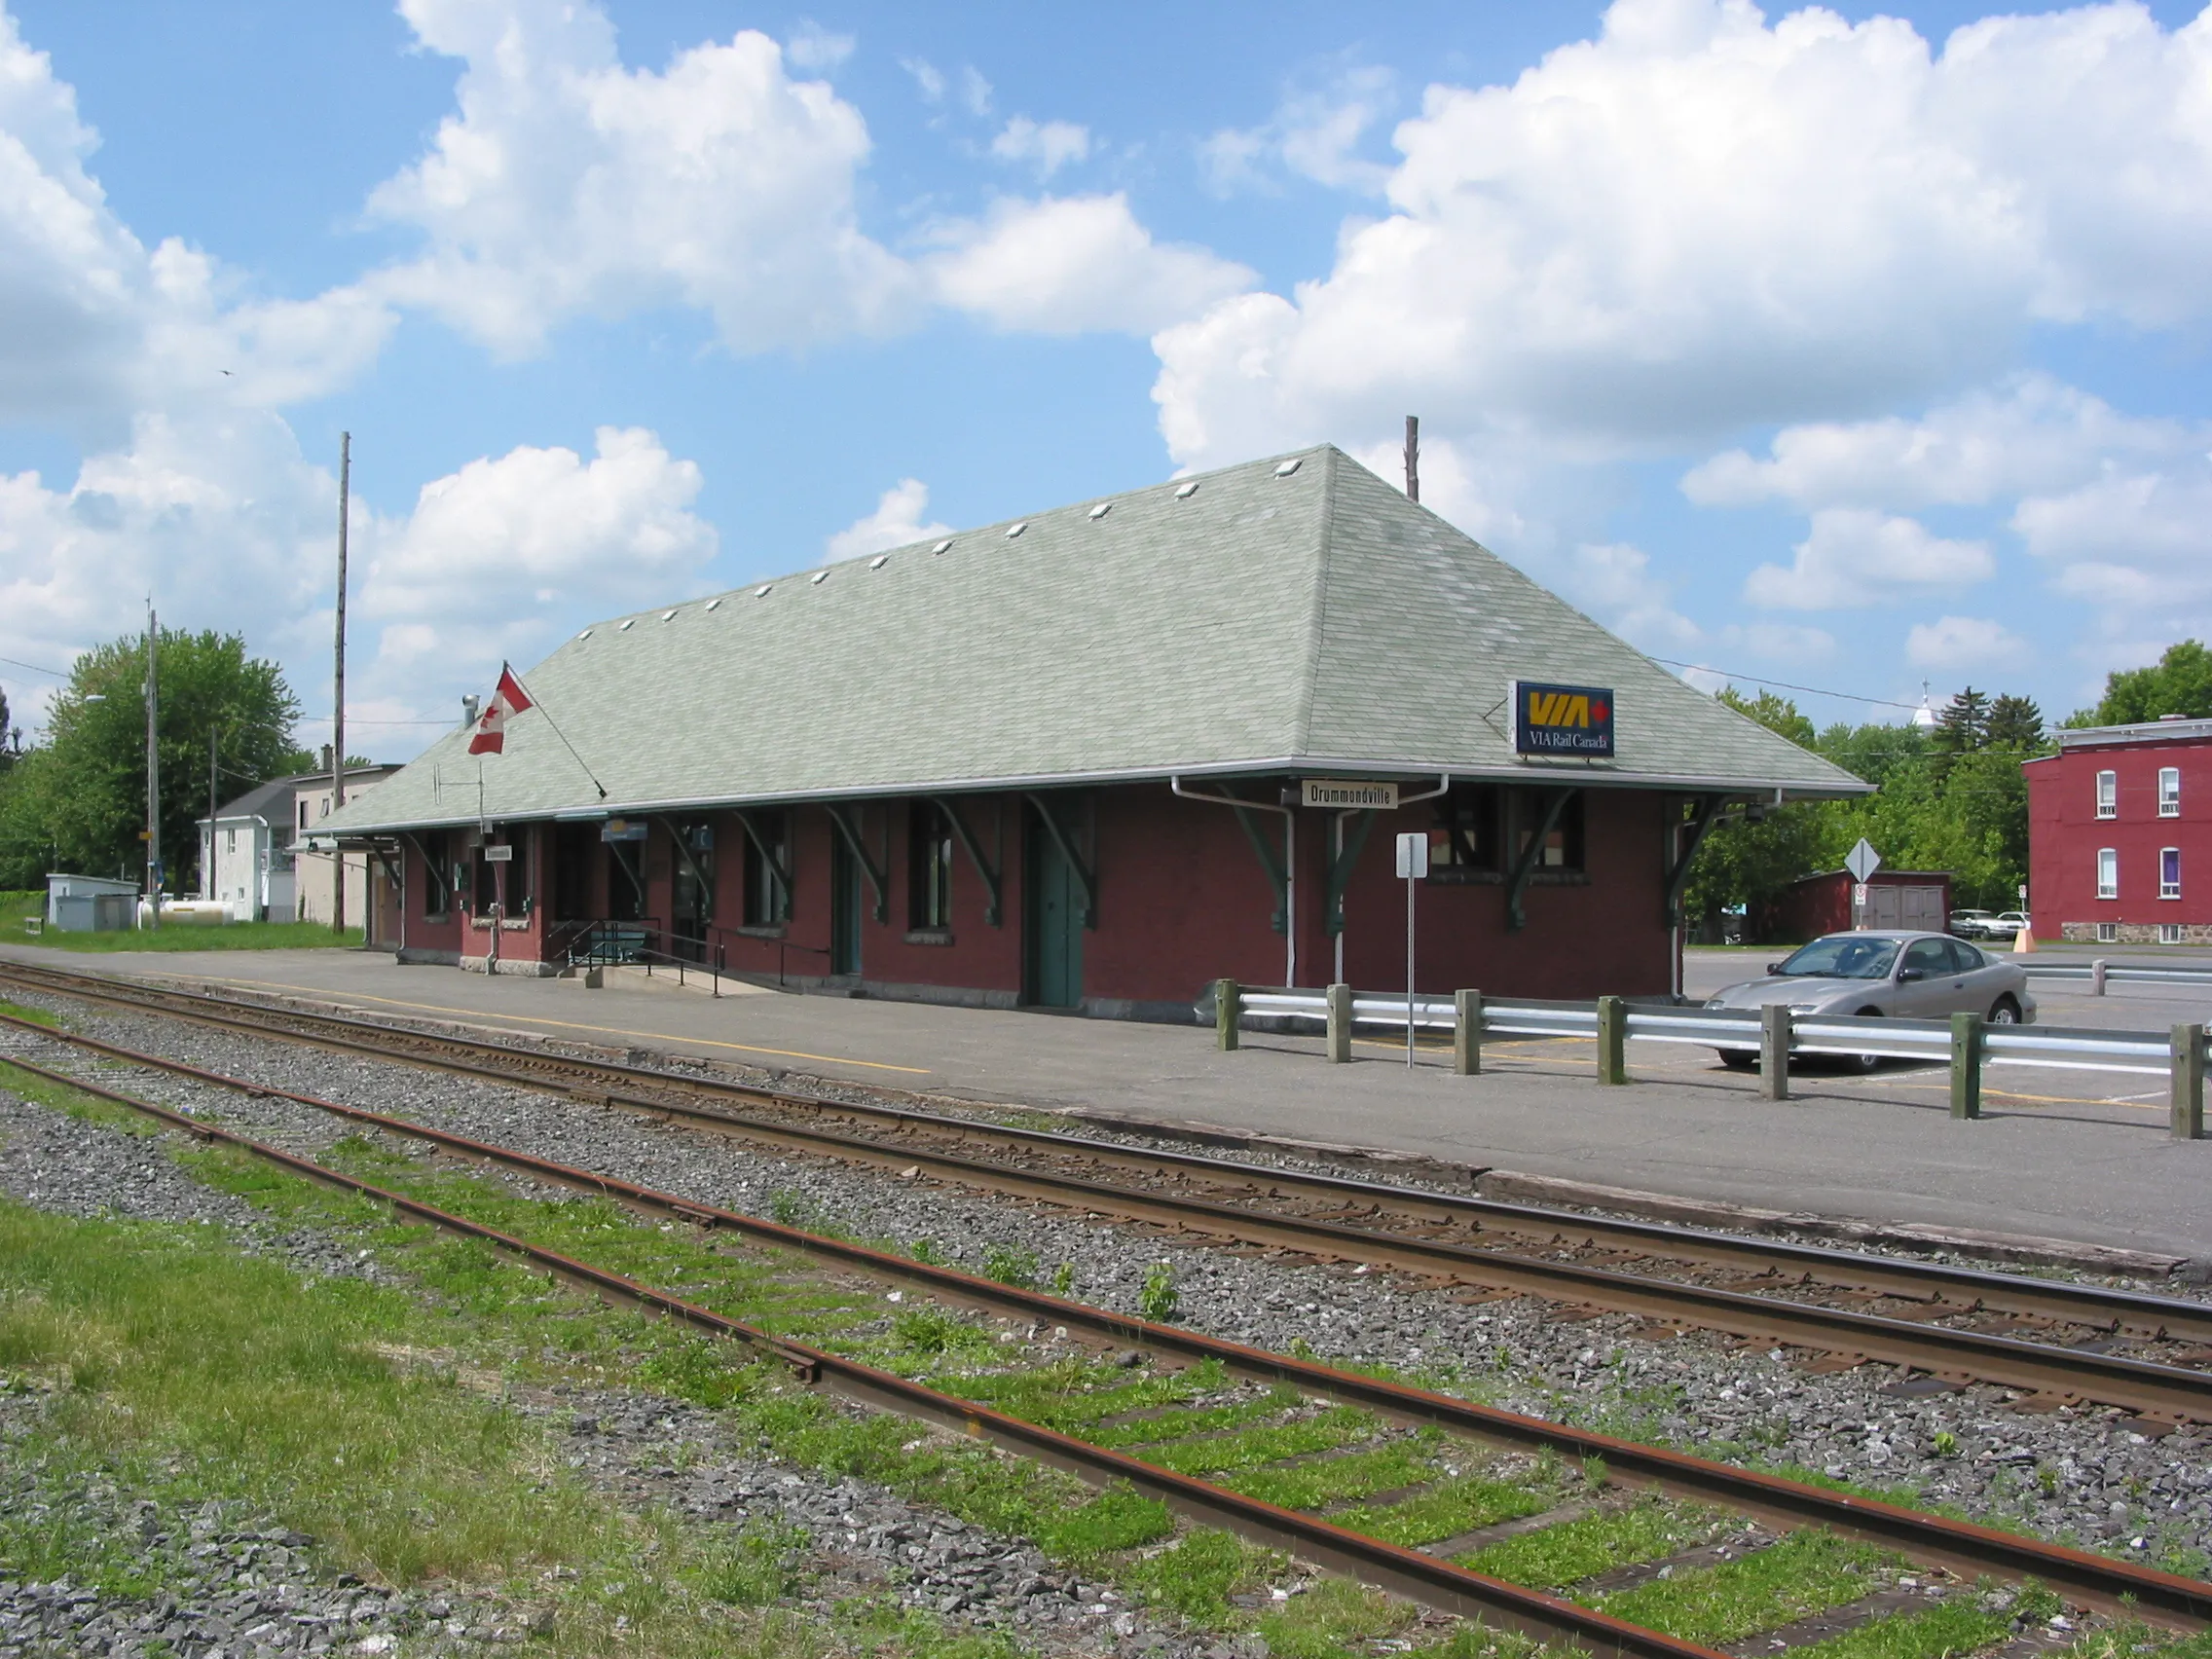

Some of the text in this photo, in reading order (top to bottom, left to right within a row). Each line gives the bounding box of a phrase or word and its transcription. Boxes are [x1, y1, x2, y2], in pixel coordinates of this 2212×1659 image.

[1530, 692, 1589, 728] VIA
[1530, 731, 1607, 749] VIA Rail Canada
[1310, 785, 1390, 804] Drummondville
